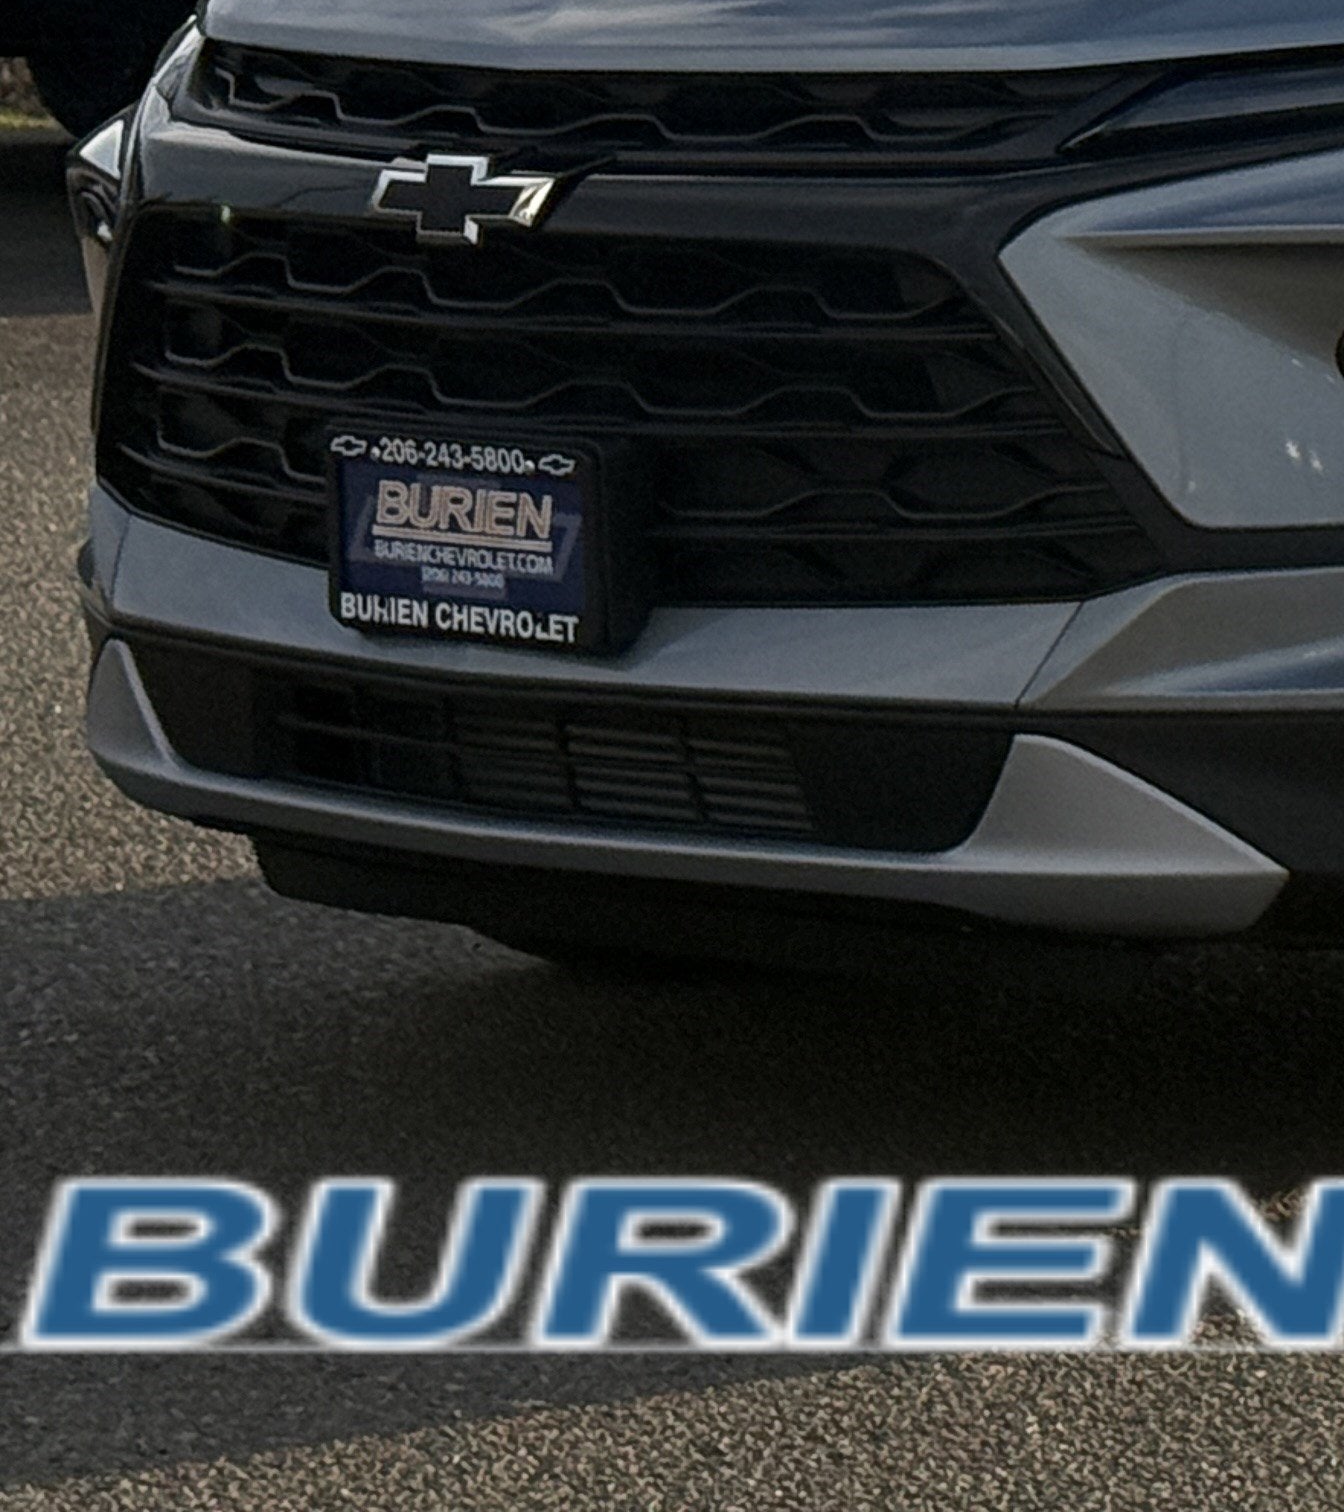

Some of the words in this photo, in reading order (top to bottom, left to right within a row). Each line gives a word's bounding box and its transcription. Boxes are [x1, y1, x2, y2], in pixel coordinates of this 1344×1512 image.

[379, 438, 524, 474] 206-243-5800
[375, 479, 552, 539] BURIEN
[435, 603, 579, 643] CHEVROLET
